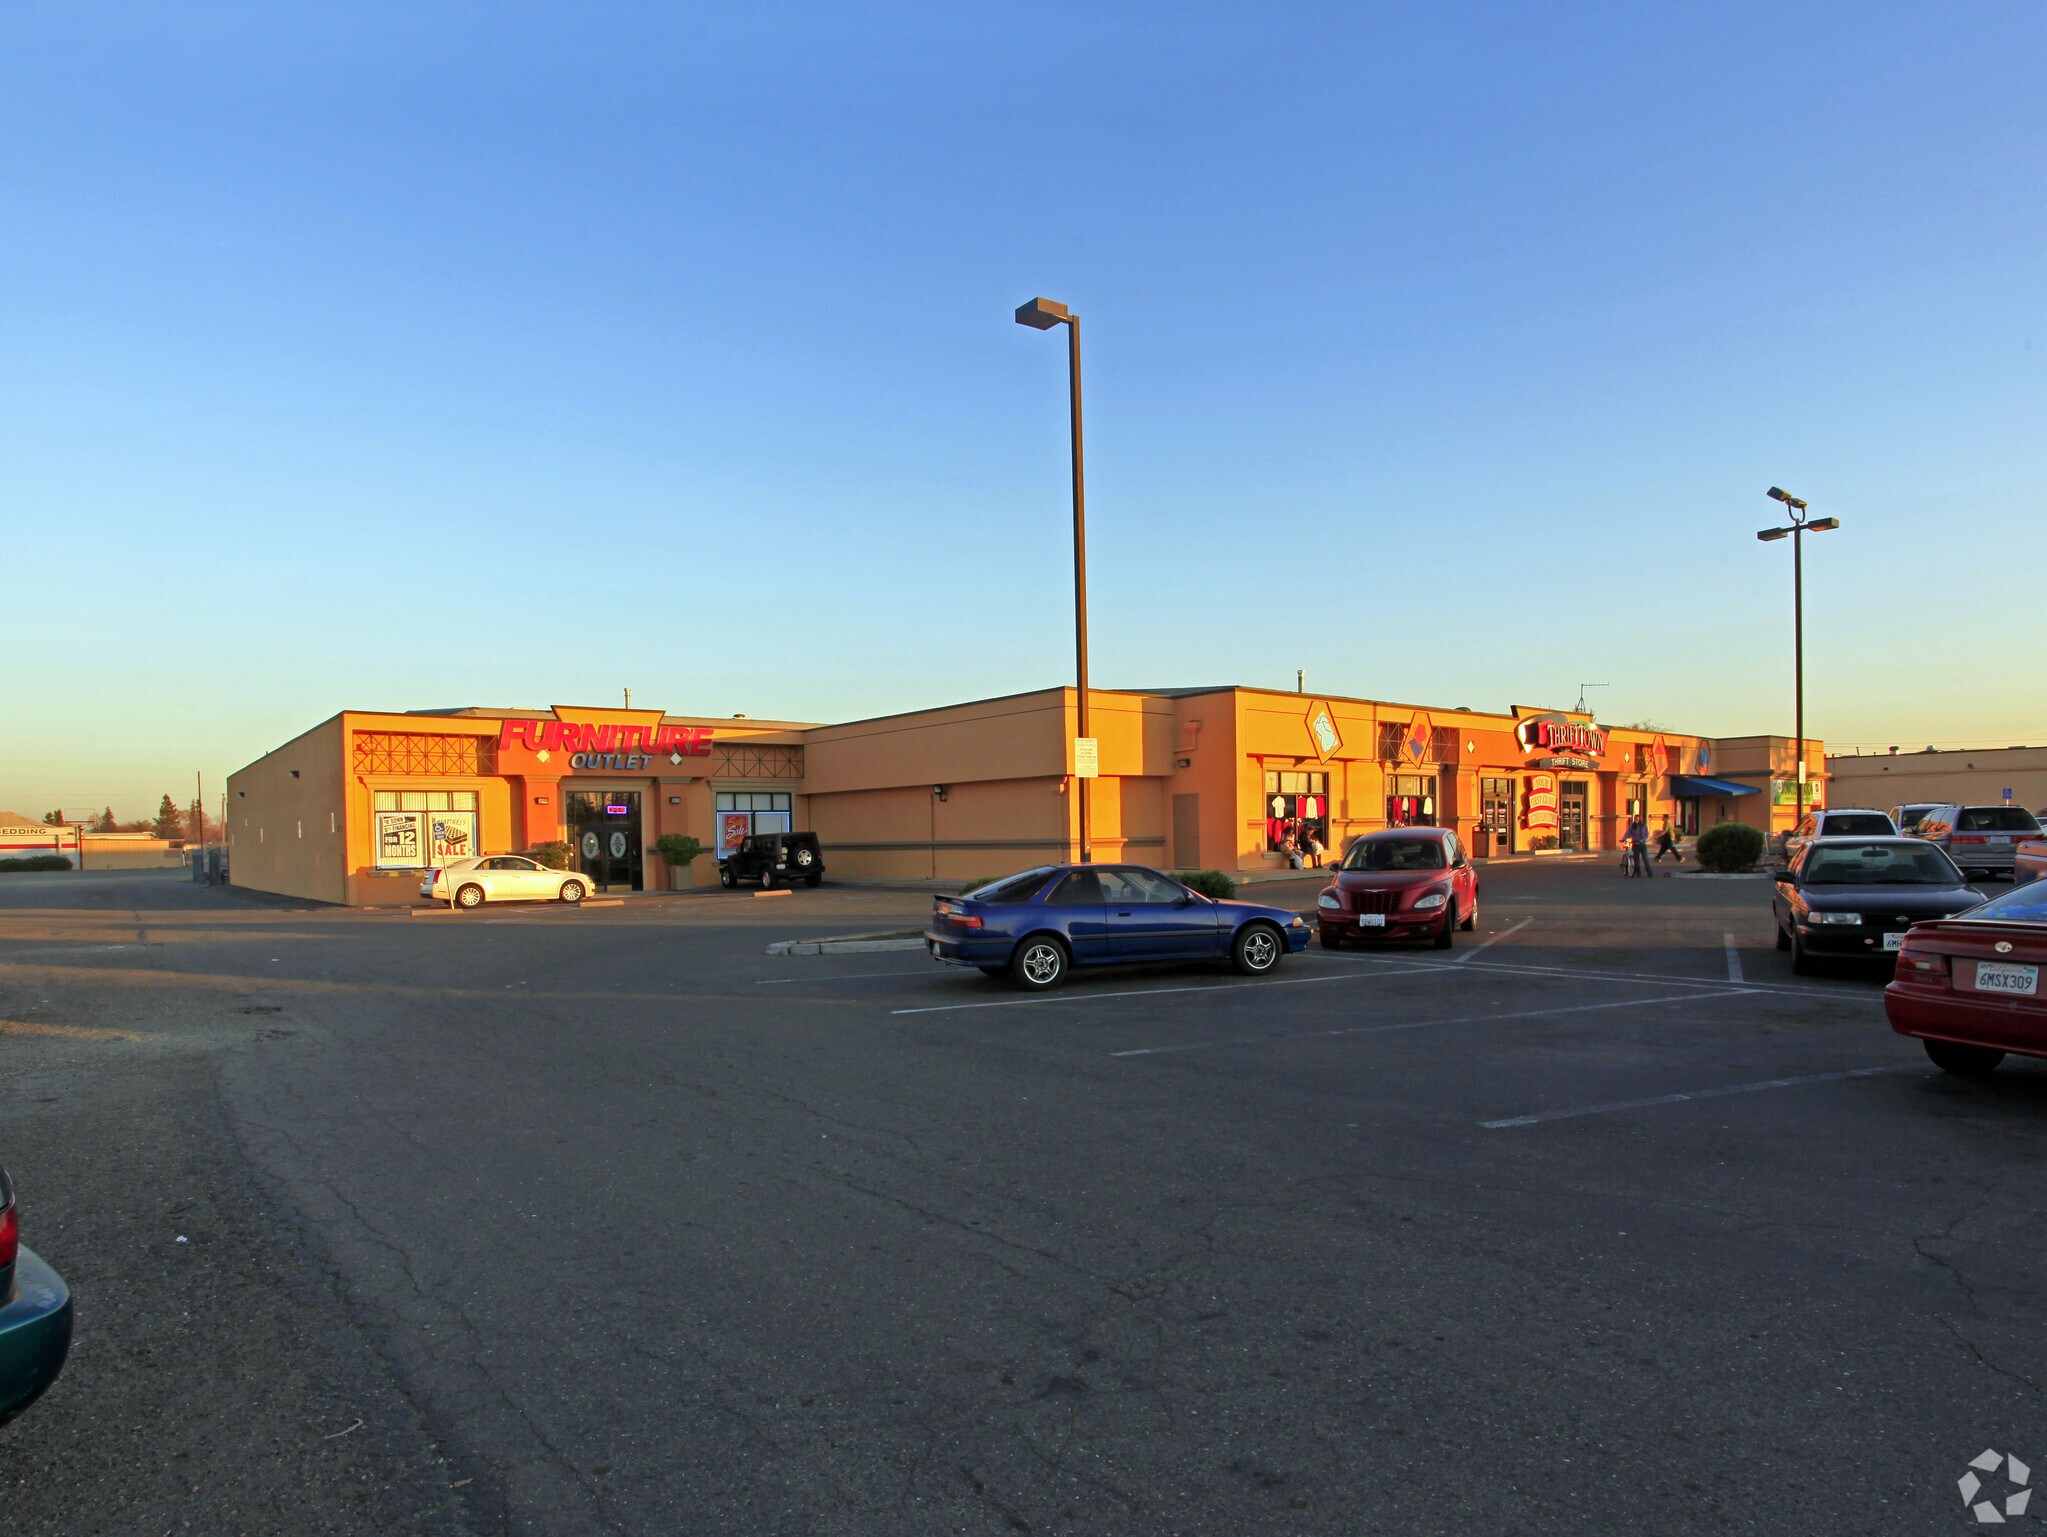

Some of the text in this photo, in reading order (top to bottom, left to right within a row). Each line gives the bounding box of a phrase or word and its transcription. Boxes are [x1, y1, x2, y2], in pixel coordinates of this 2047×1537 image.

[500, 719, 714, 756] FURNITURE
[571, 752, 652, 769] OUTLET
[1551, 757, 1589, 768] THRIFT STORE
[392, 823, 416, 832] FINANCING
[726, 824, 747, 839] Sale
[398, 831, 415, 844] 12
[385, 844, 416, 857] MONTHS
[437, 844, 466, 856] SALE
[1979, 972, 2033, 990] 6MSX309
